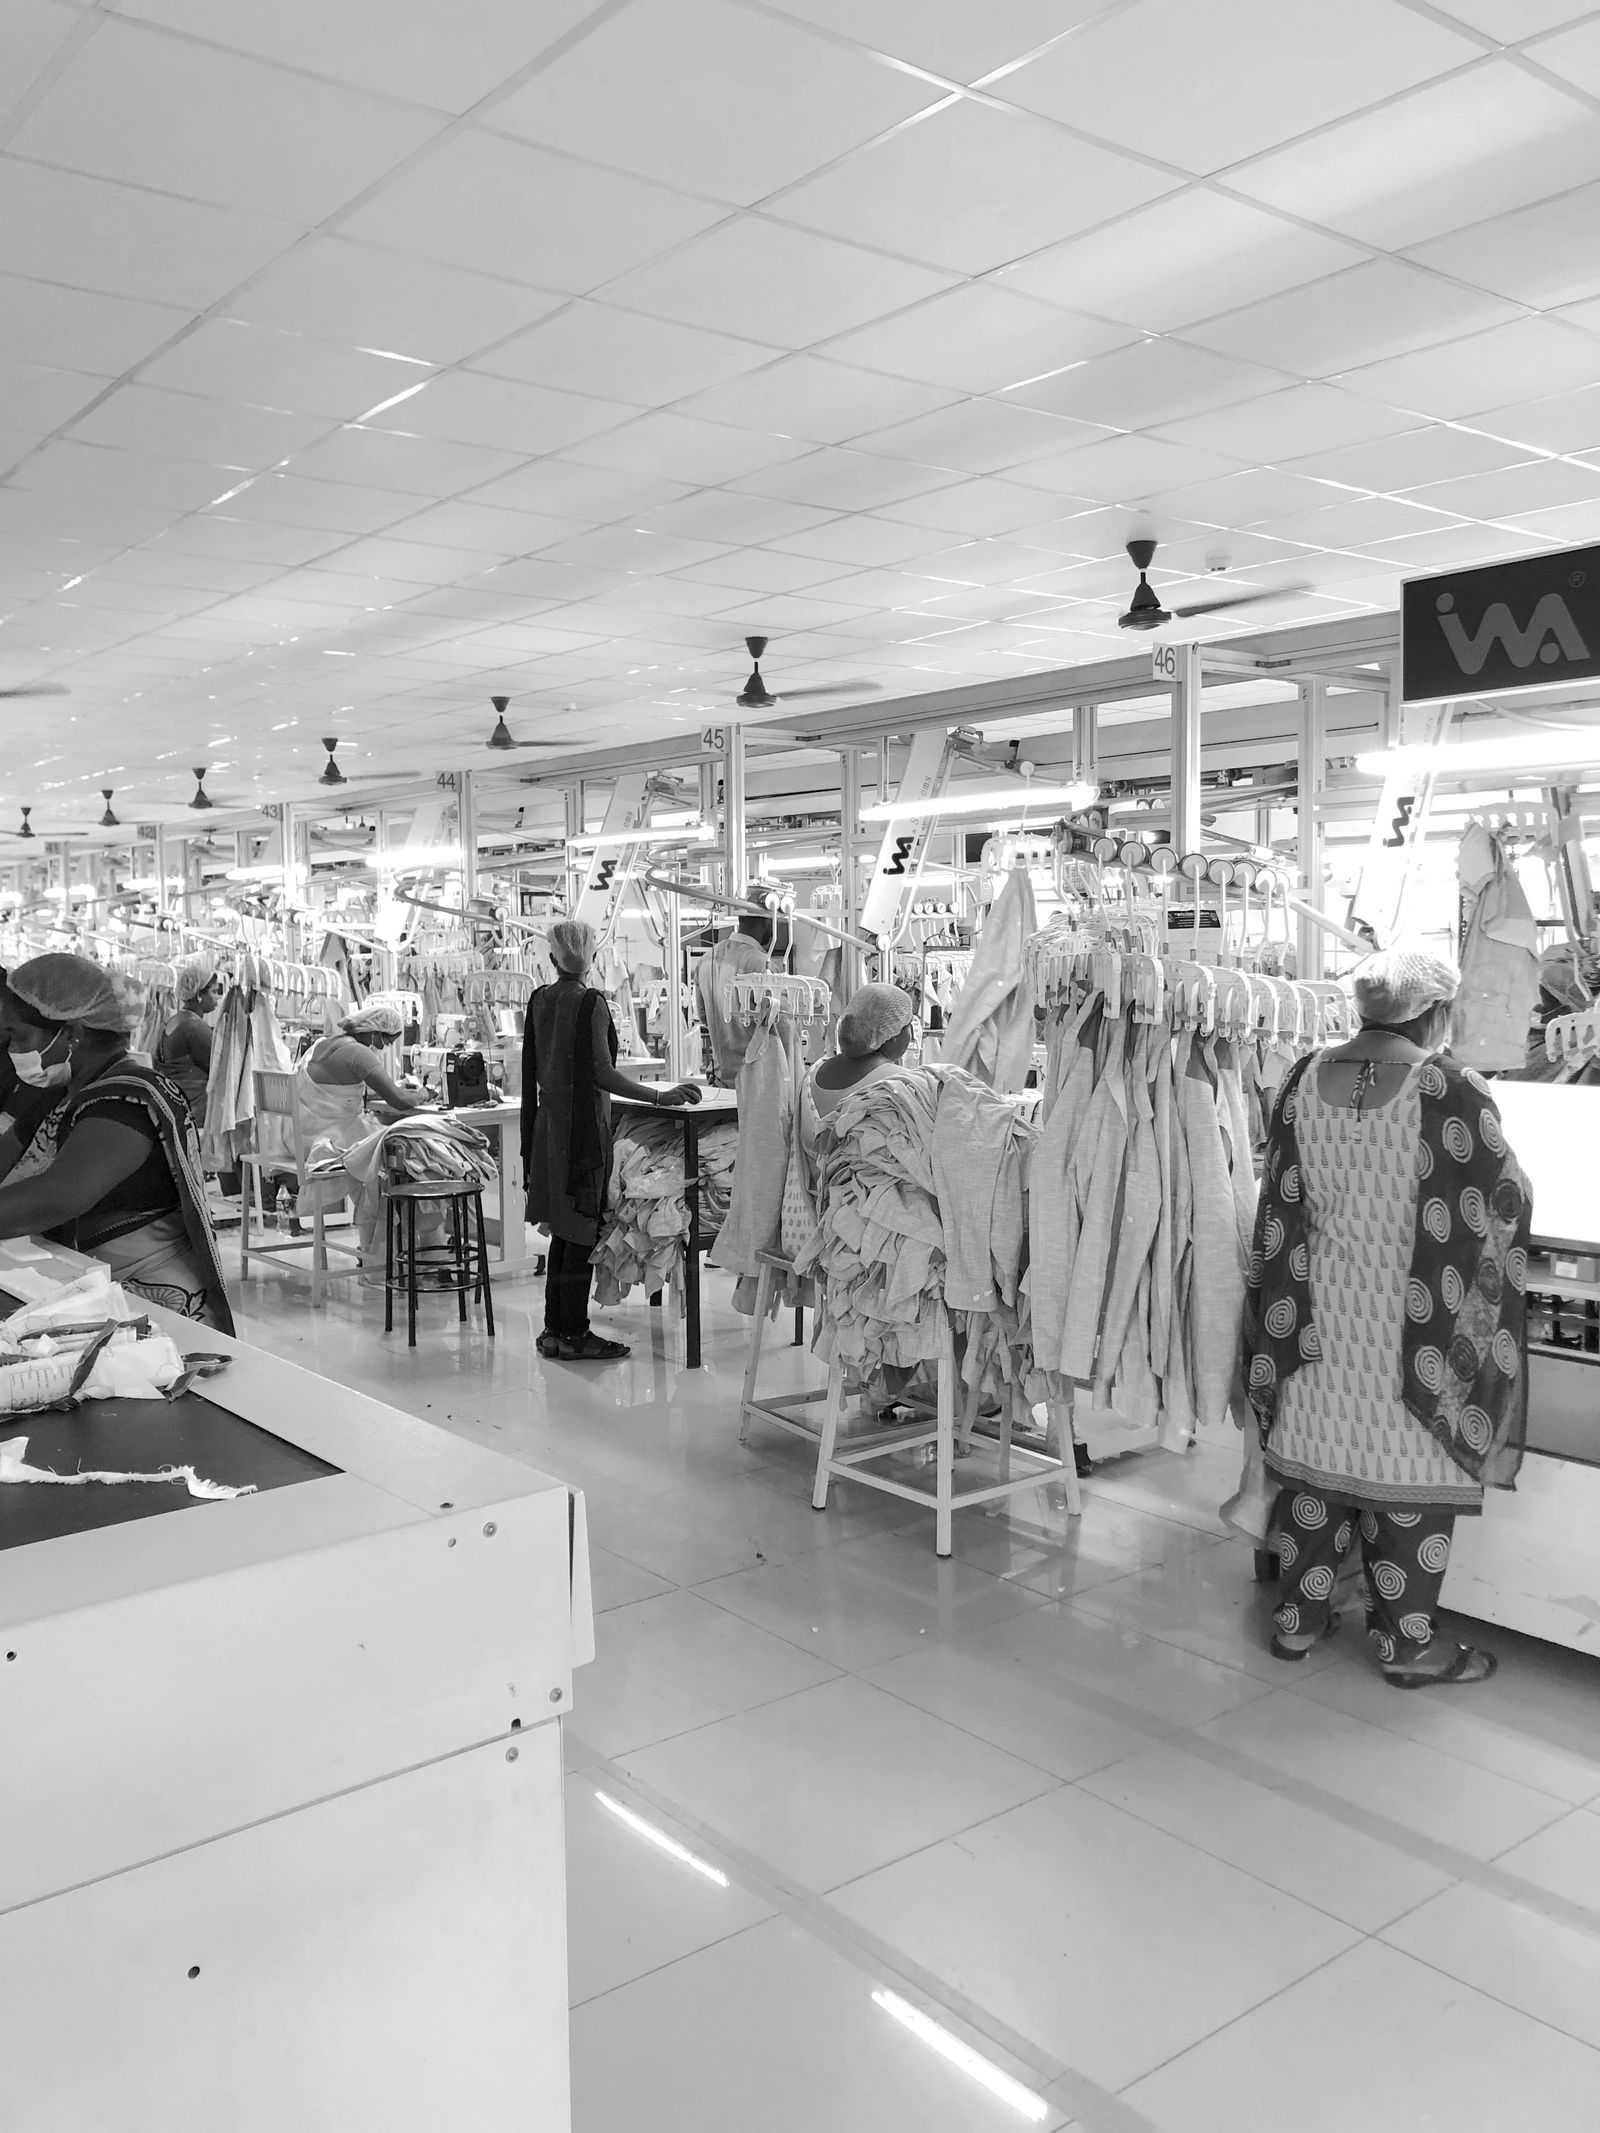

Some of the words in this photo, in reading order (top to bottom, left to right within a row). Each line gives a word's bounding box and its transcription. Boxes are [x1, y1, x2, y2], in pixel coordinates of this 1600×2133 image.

[1154, 646, 1175, 675] 46
[703, 727, 725, 749] 45
[437, 773, 456, 789] 44
[261, 804, 278, 818] 43
